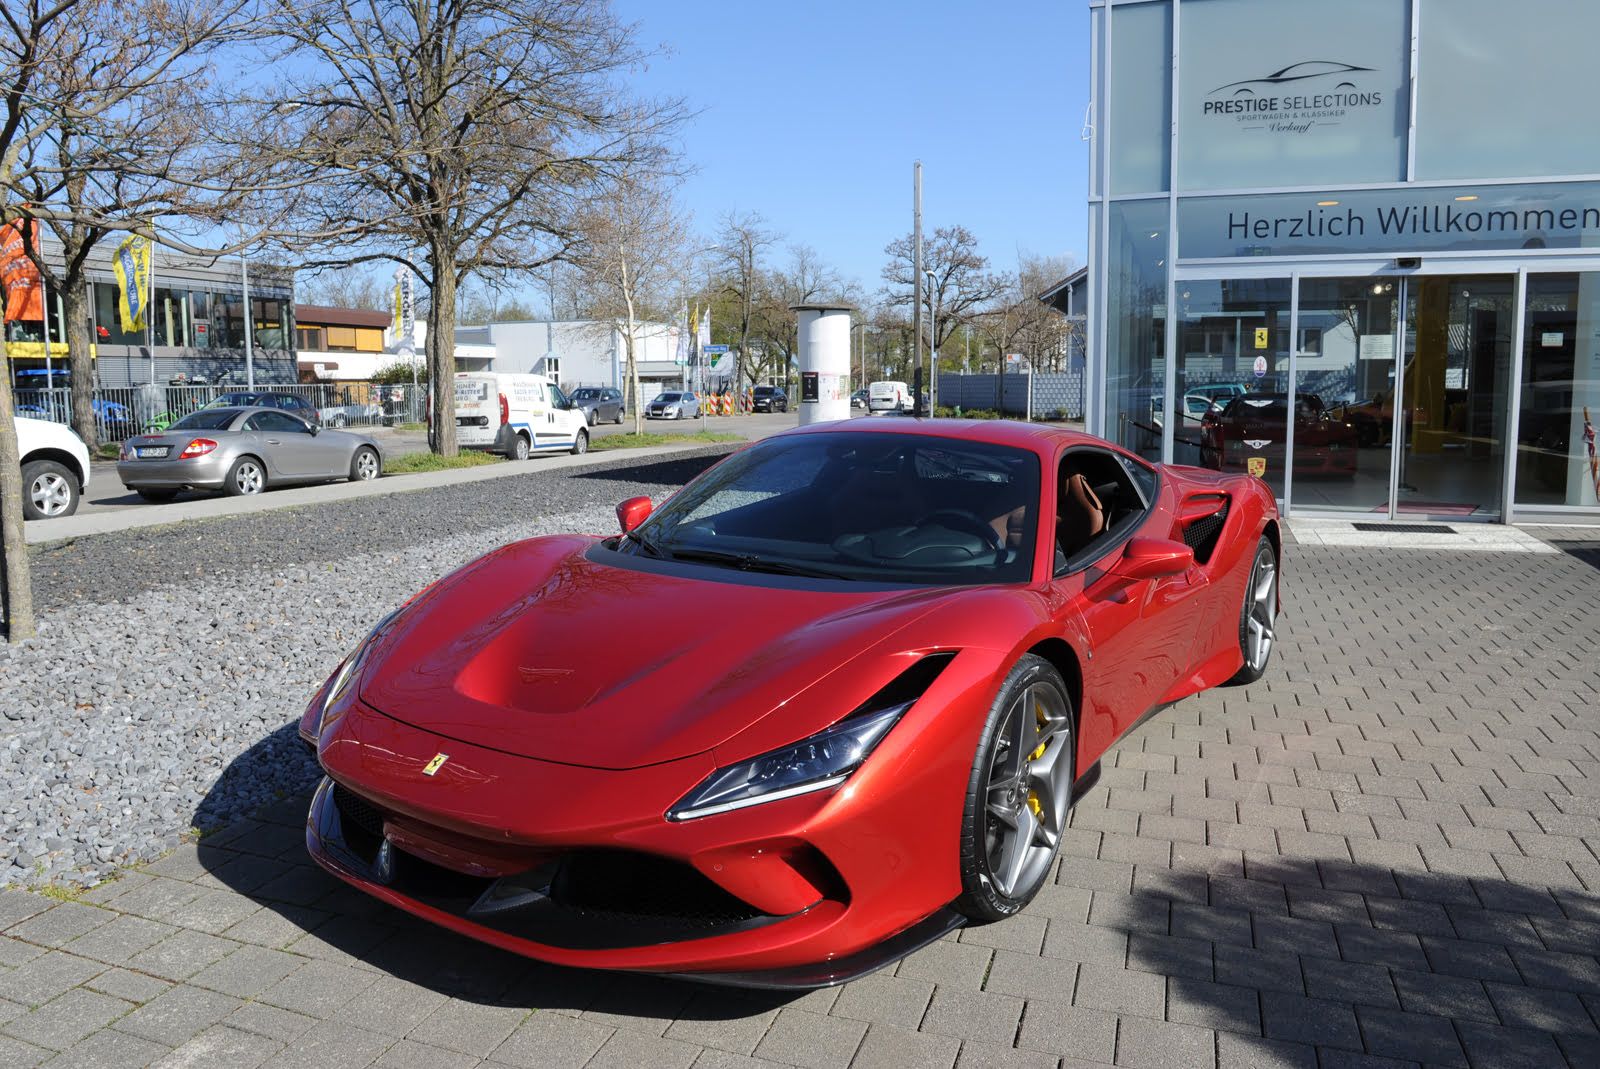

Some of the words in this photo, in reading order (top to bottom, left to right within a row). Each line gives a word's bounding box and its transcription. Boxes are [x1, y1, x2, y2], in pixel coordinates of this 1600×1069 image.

[1204, 97, 1279, 115] PRESTIGE
[1283, 92, 1382, 110] SELECTIONS
[1236, 112, 1290, 122] SPORTWAGEN
[1293, 111, 1298, 119] &
[1301, 109, 1346, 119] KLASSIKER
[1269, 120, 1316, 134] Verkauf
[1228, 208, 1365, 240] Herzlich
[1377, 204, 1600, 235] Willkommen
